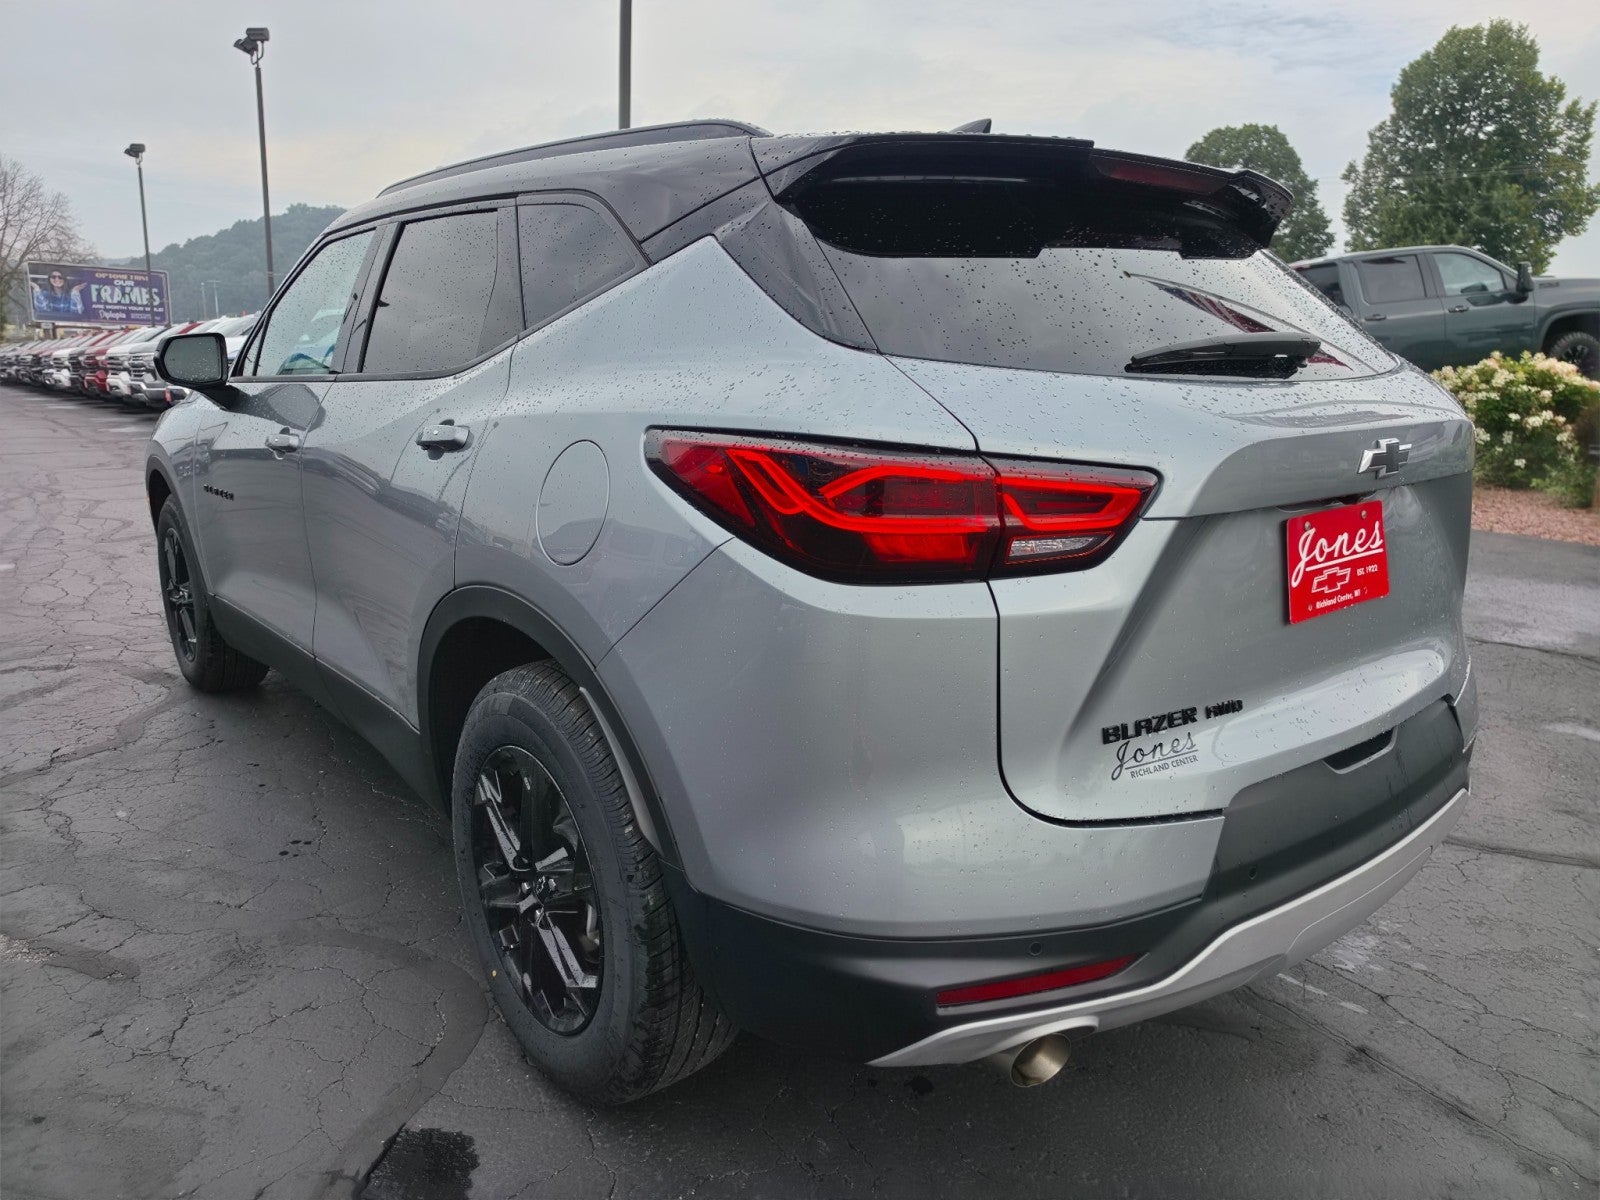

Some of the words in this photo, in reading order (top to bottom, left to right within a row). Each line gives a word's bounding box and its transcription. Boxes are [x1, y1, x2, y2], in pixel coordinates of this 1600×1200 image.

[91, 284, 160, 306] FRAMES
[1291, 521, 1383, 588] Jones
[1316, 596, 1337, 609] Richland
[1102, 706, 1198, 745] BLAZER
[1204, 699, 1244, 719] AWD
[1111, 731, 1197, 781] Jones
[1130, 761, 1170, 780] RICHLAND
[1170, 754, 1199, 768] CENTER
